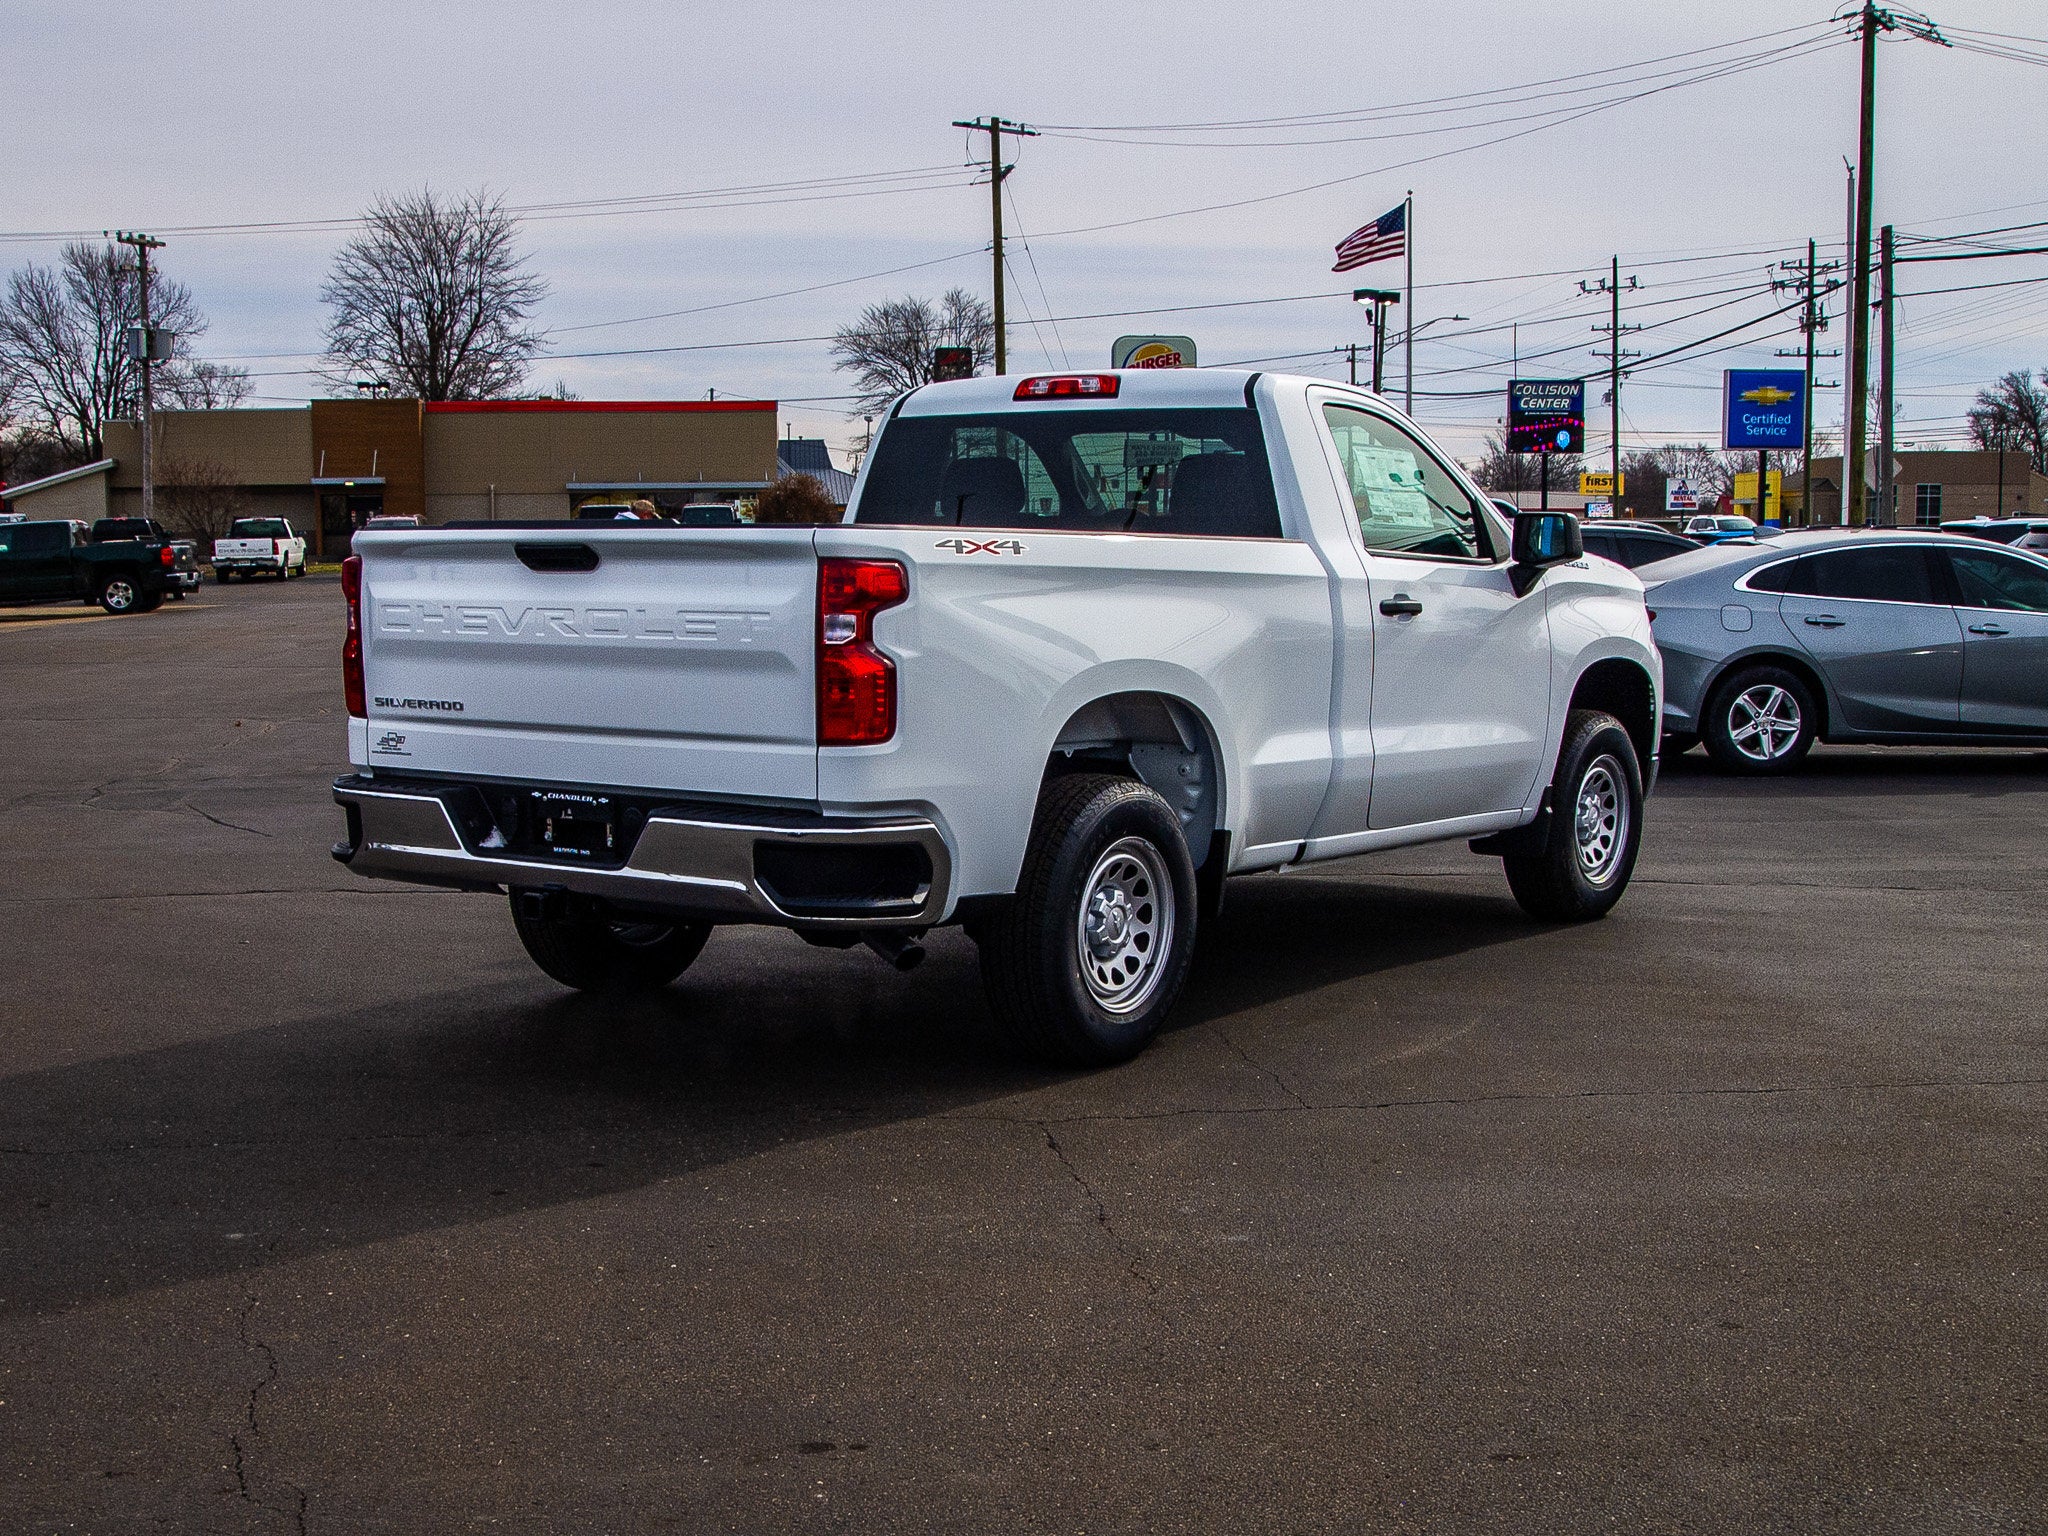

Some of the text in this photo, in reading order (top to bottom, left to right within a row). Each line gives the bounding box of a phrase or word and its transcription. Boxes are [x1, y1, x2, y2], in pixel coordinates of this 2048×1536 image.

[1515, 384, 1579, 396] COLLISION
[1520, 398, 1570, 409] CENTER
[1743, 413, 1791, 425] Certified
[1746, 425, 1787, 436] Service
[381, 604, 772, 643] CHEVROLET
[374, 697, 464, 711] SILVERADO
[548, 792, 593, 803] CHANDLER
